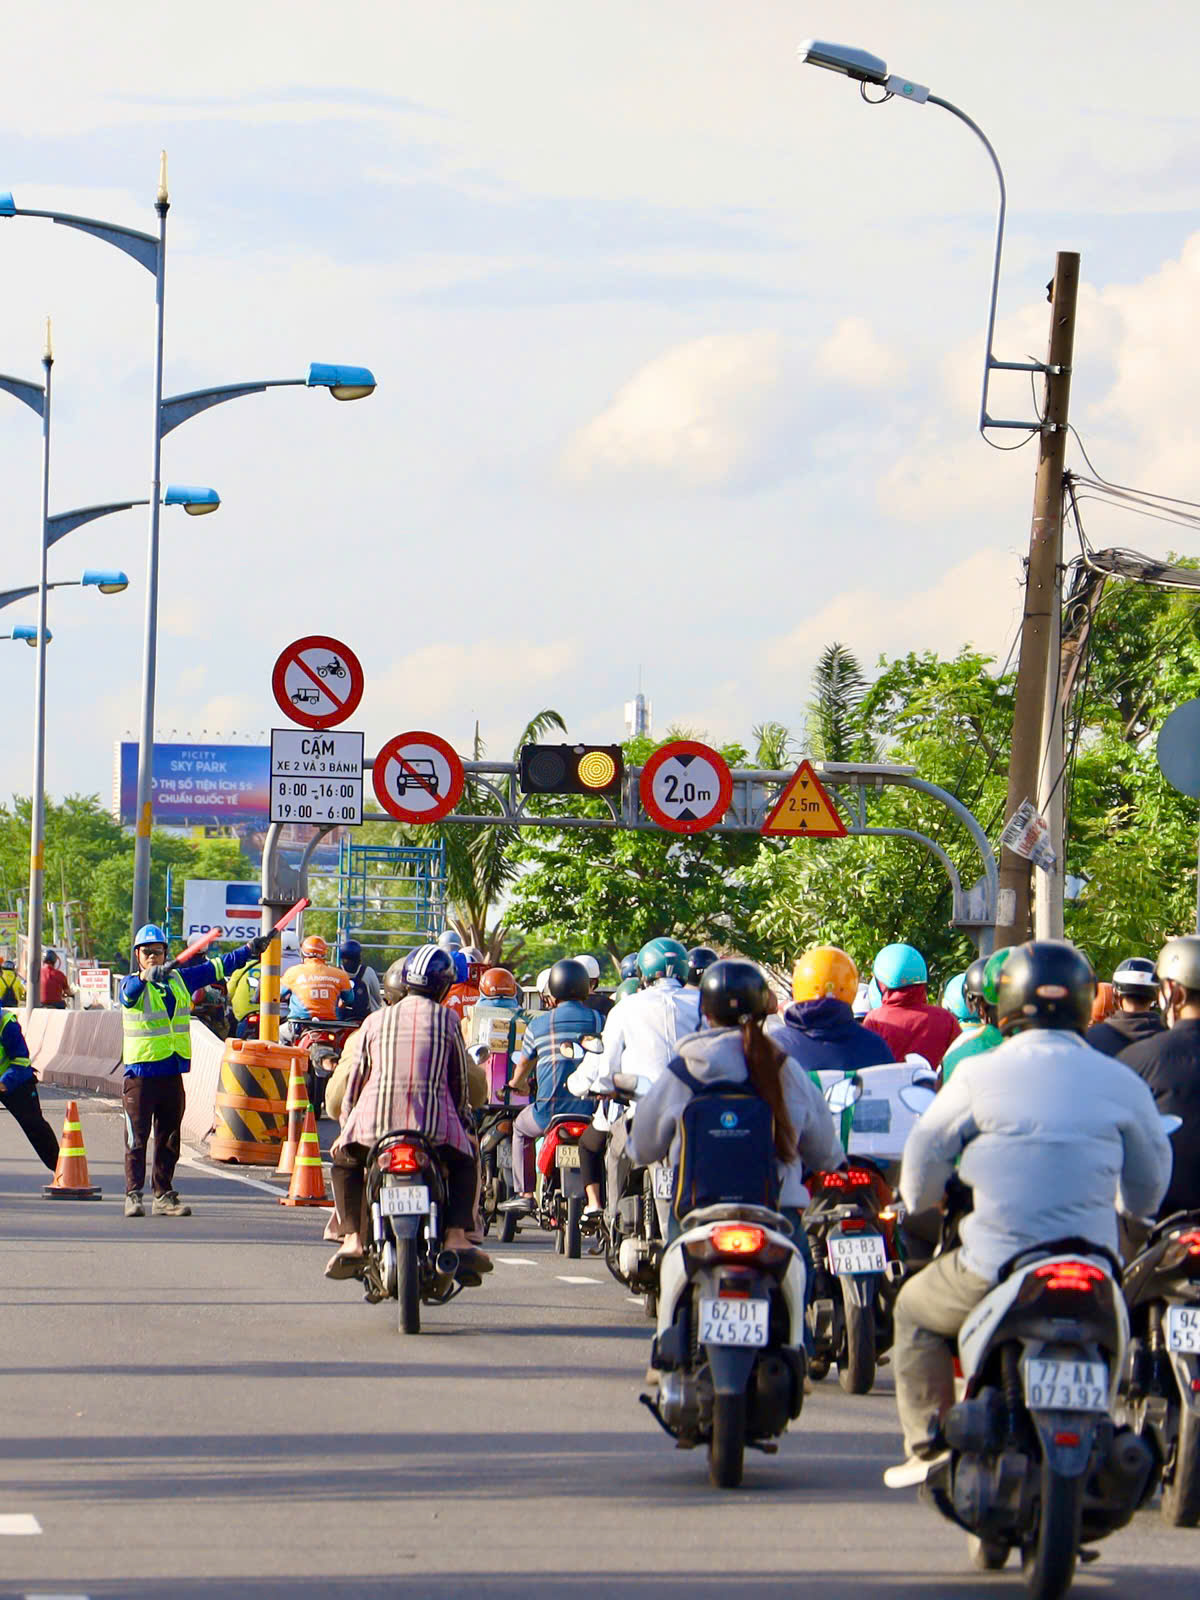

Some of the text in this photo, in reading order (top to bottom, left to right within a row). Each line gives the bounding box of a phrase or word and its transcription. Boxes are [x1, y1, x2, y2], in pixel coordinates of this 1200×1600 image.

[301, 735, 334, 756] CẤM
[182, 751, 216, 760] PICITY
[170, 760, 227, 773] SKY PARK
[277, 760, 358, 773] XE 2 VÀ 3 BÁNH
[160, 779, 177, 791] THỊ
[195, 778, 217, 791] TIỆN
[218, 778, 237, 790] ÍCH
[279, 783, 307, 797] 8:00
[194, 791, 225, 806] QUỐC
[227, 792, 239, 806] TẾ
[789, 798, 820, 812] 2.5m
[278, 804, 312, 818] 19:00
[328, 806, 355, 820] 6:00
[389, 1200, 422, 1213] 0014
[704, 1322, 763, 1343] 245.25
